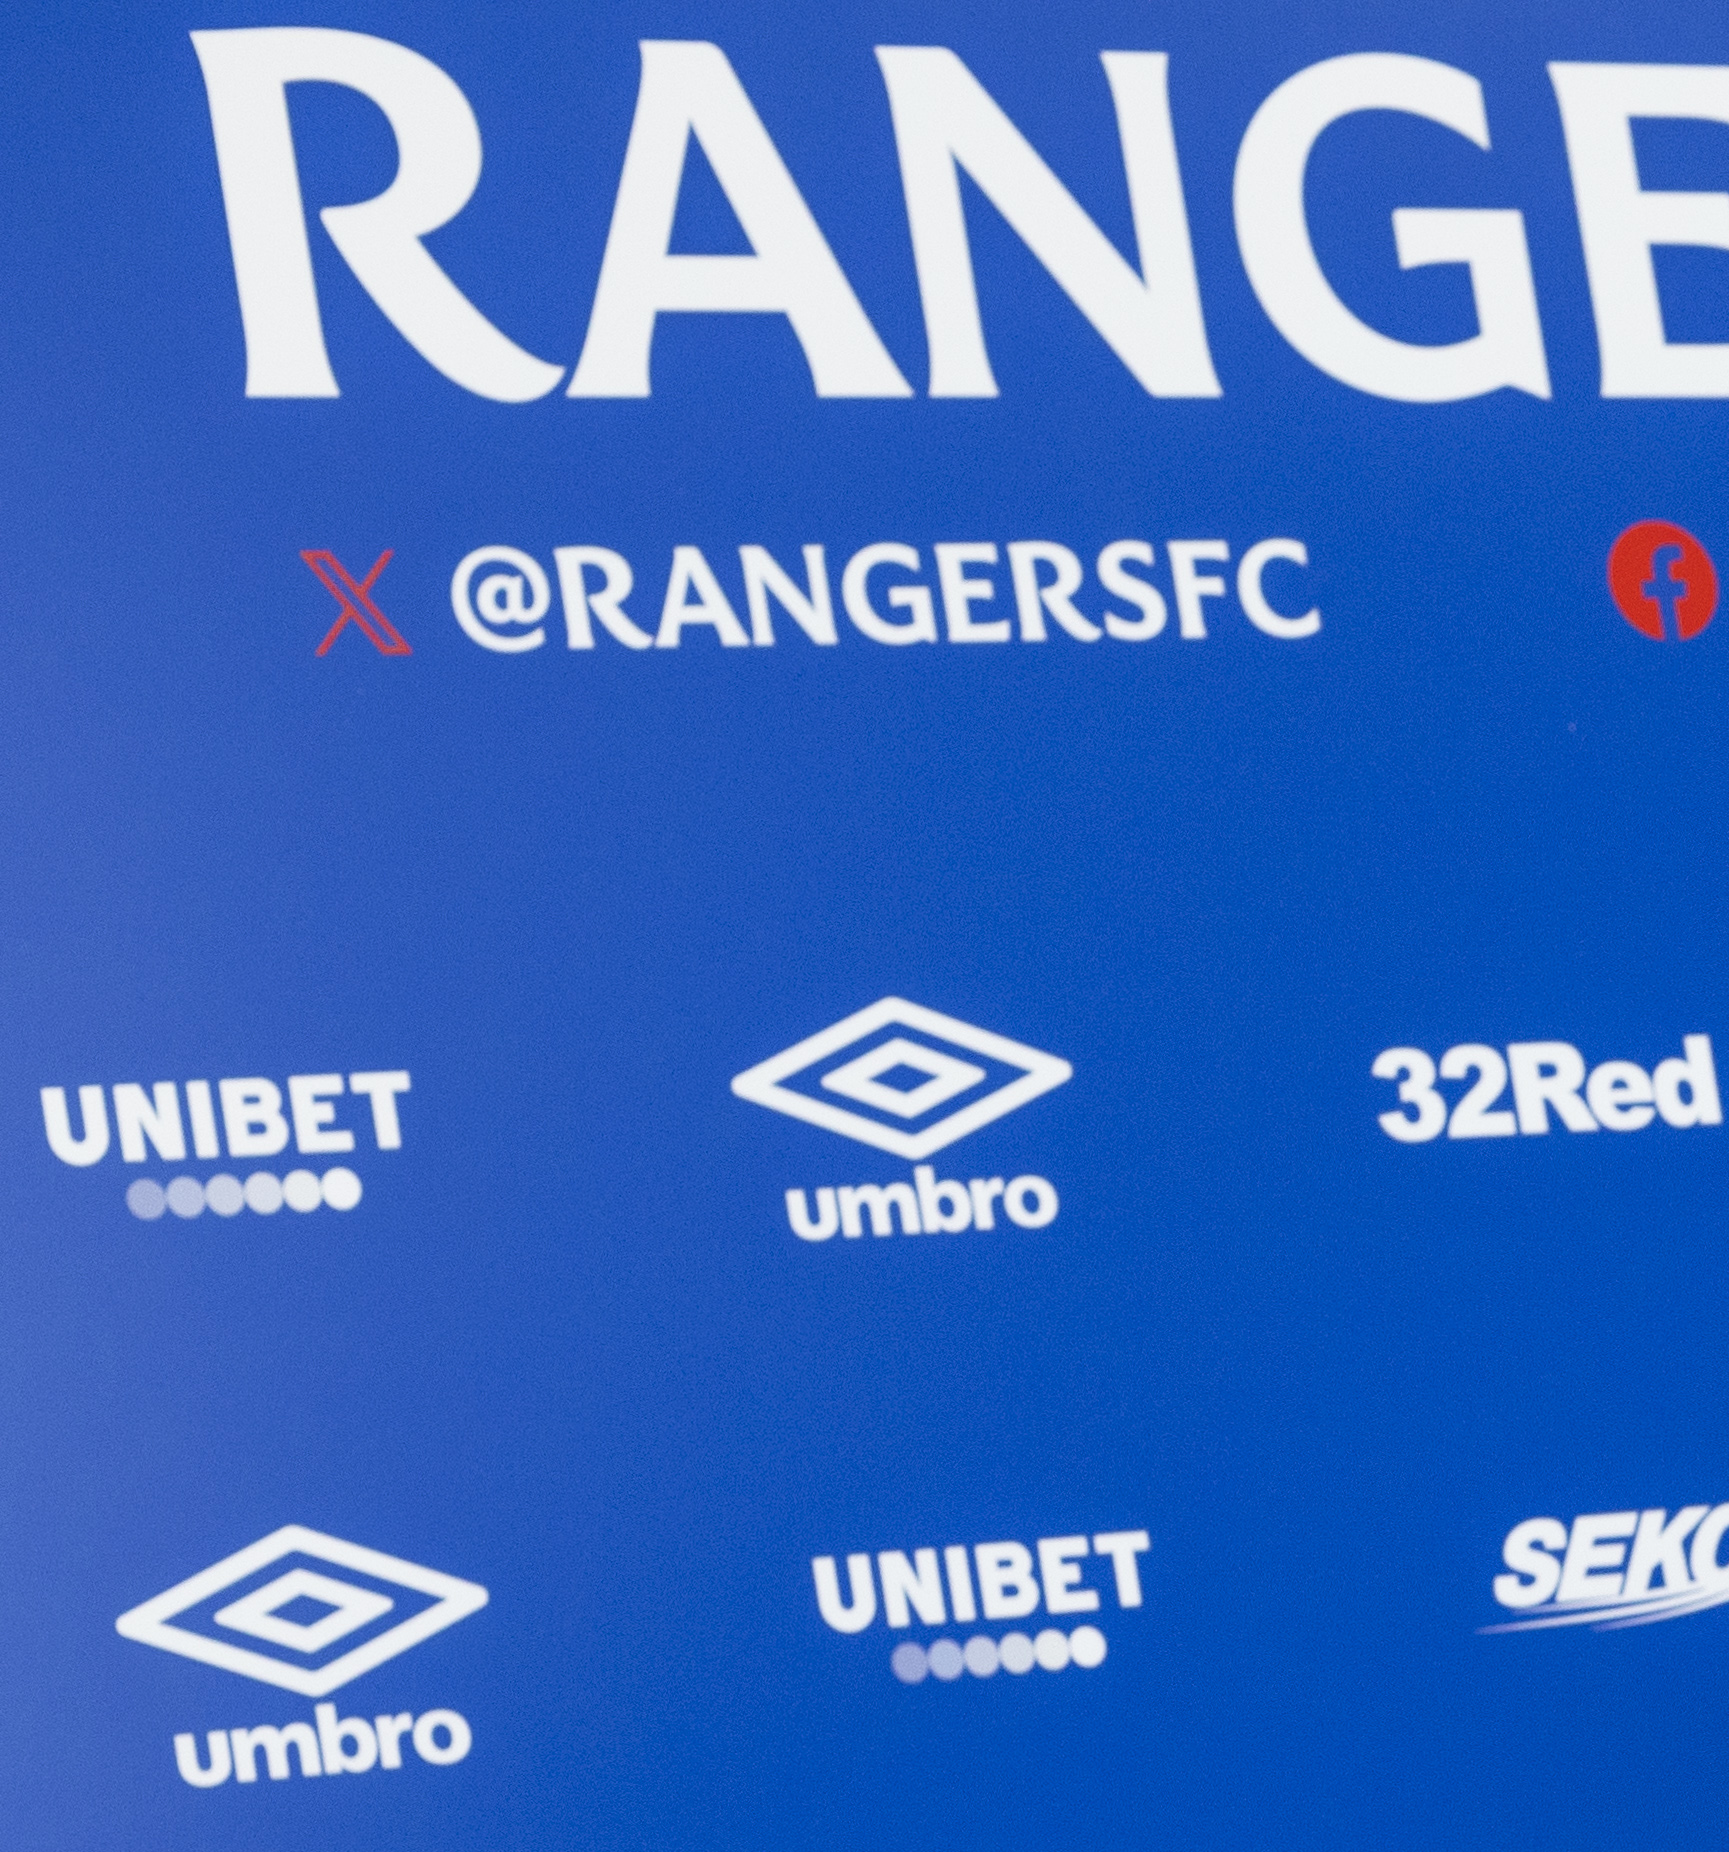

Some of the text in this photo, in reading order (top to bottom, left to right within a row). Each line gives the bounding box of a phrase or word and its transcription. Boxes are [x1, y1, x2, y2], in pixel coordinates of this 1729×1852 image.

[450, 537, 1322, 654] @RANGERSFC
[40, 1070, 411, 1168] UNIBET
[1371, 1033, 1723, 1144] 32Red
[784, 1165, 1059, 1242] umbro
[811, 1529, 1151, 1635] UNIBET
[173, 1703, 472, 1789] umbro
